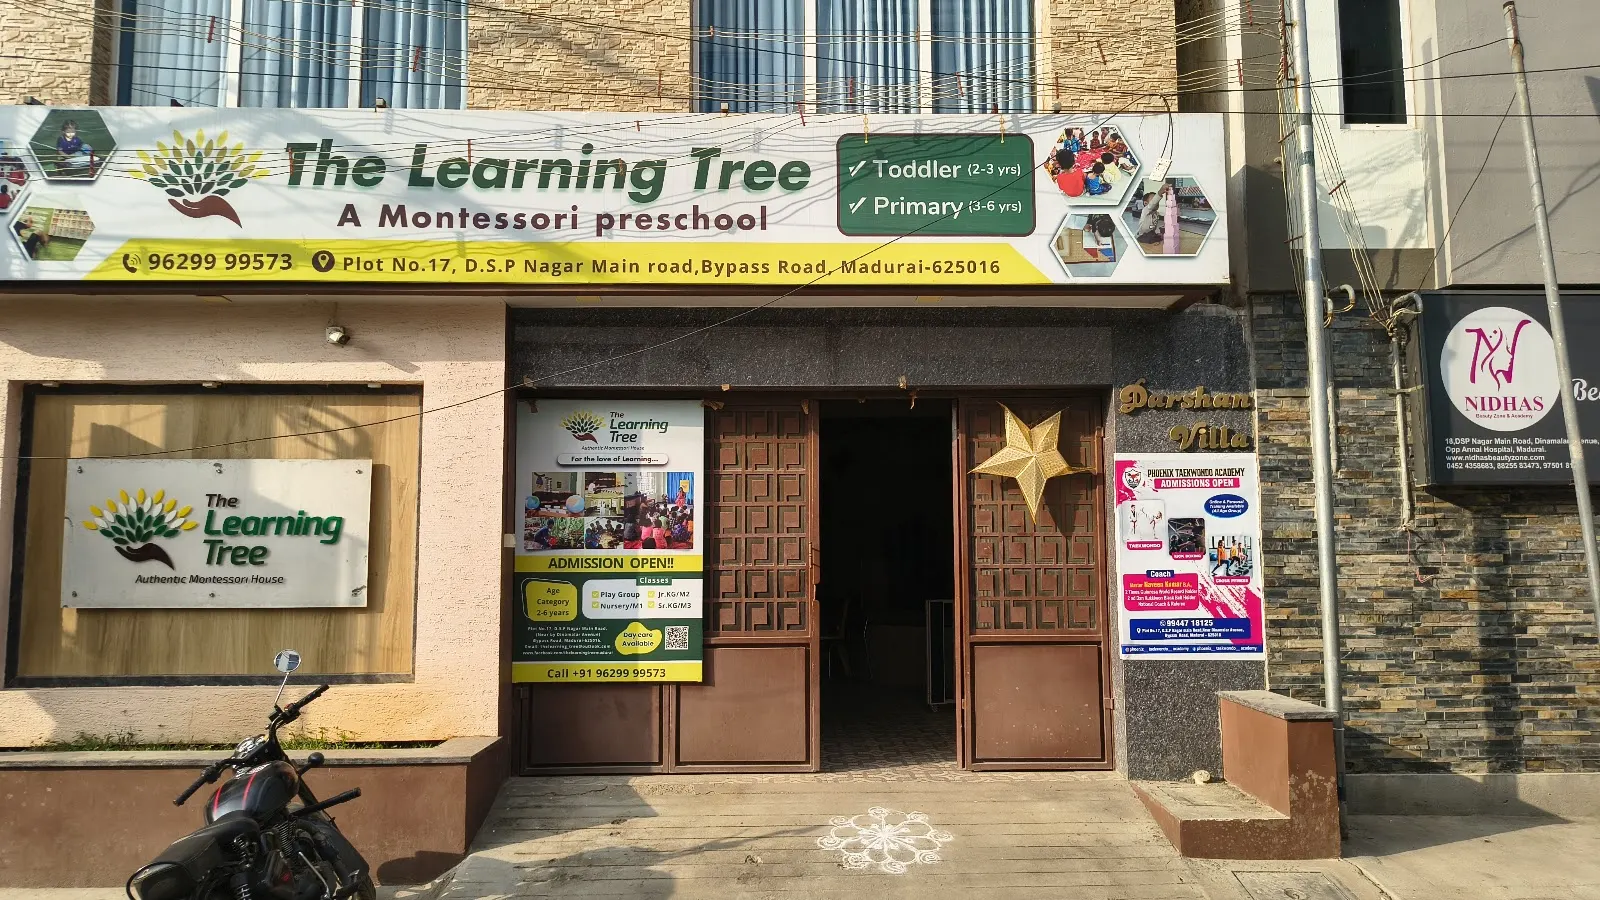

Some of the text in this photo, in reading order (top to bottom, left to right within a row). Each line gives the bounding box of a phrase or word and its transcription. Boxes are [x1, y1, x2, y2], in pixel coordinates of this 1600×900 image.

[286, 139, 811, 203] The Learning Tree
[873, 160, 1021, 178] Toddler (2-3 yrs)
[874, 197, 1022, 219] Primary (3-6 yrs)
[337, 204, 767, 236] A Montessori preschool
[149, 253, 293, 270] 96299 99573
[343, 257, 384, 271] Plot
[393, 257, 456, 275] No.17,
[465, 259, 515, 273] D.S.P
[524, 259, 584, 276] Nagar
[592, 258, 640, 274] Main
[778, 258, 832, 276] Road,
[841, 259, 1000, 274] Madurai-625016
[1119, 378, 1251, 413] Darshan
[1572, 378, 1600, 401] Be
[1465, 396, 1544, 411] NIDHAS
[609, 419, 669, 434] Learning
[610, 431, 638, 442] Tree
[1169, 421, 1250, 450] Villa
[1471, 437, 1492, 446] Nagar
[1494, 437, 1511, 445] Main
[1513, 437, 1533, 446] Road,
[1445, 446, 1460, 454] Opp
[1484, 446, 1515, 454] Hospital,
[1147, 467, 1245, 477] PHOENIX TAEKWONDO ACADEMY
[1160, 478, 1234, 488] ADMISSIONS OPEN
[206, 493, 239, 508] The
[203, 509, 344, 545] Learning
[203, 539, 269, 566] Tree
[548, 557, 674, 569] ADMISSION OPEN!!
[135, 574, 285, 584] Authentic Montessori House
[639, 576, 669, 584] Classes
[546, 587, 560, 596] Age
[600, 591, 640, 599] Play Group
[536, 598, 570, 606] Category
[600, 602, 643, 610] Nursery/M1
[549, 609, 569, 617] years
[1166, 619, 1189, 627] 99447
[547, 668, 666, 679] Call +91 96299 99573
